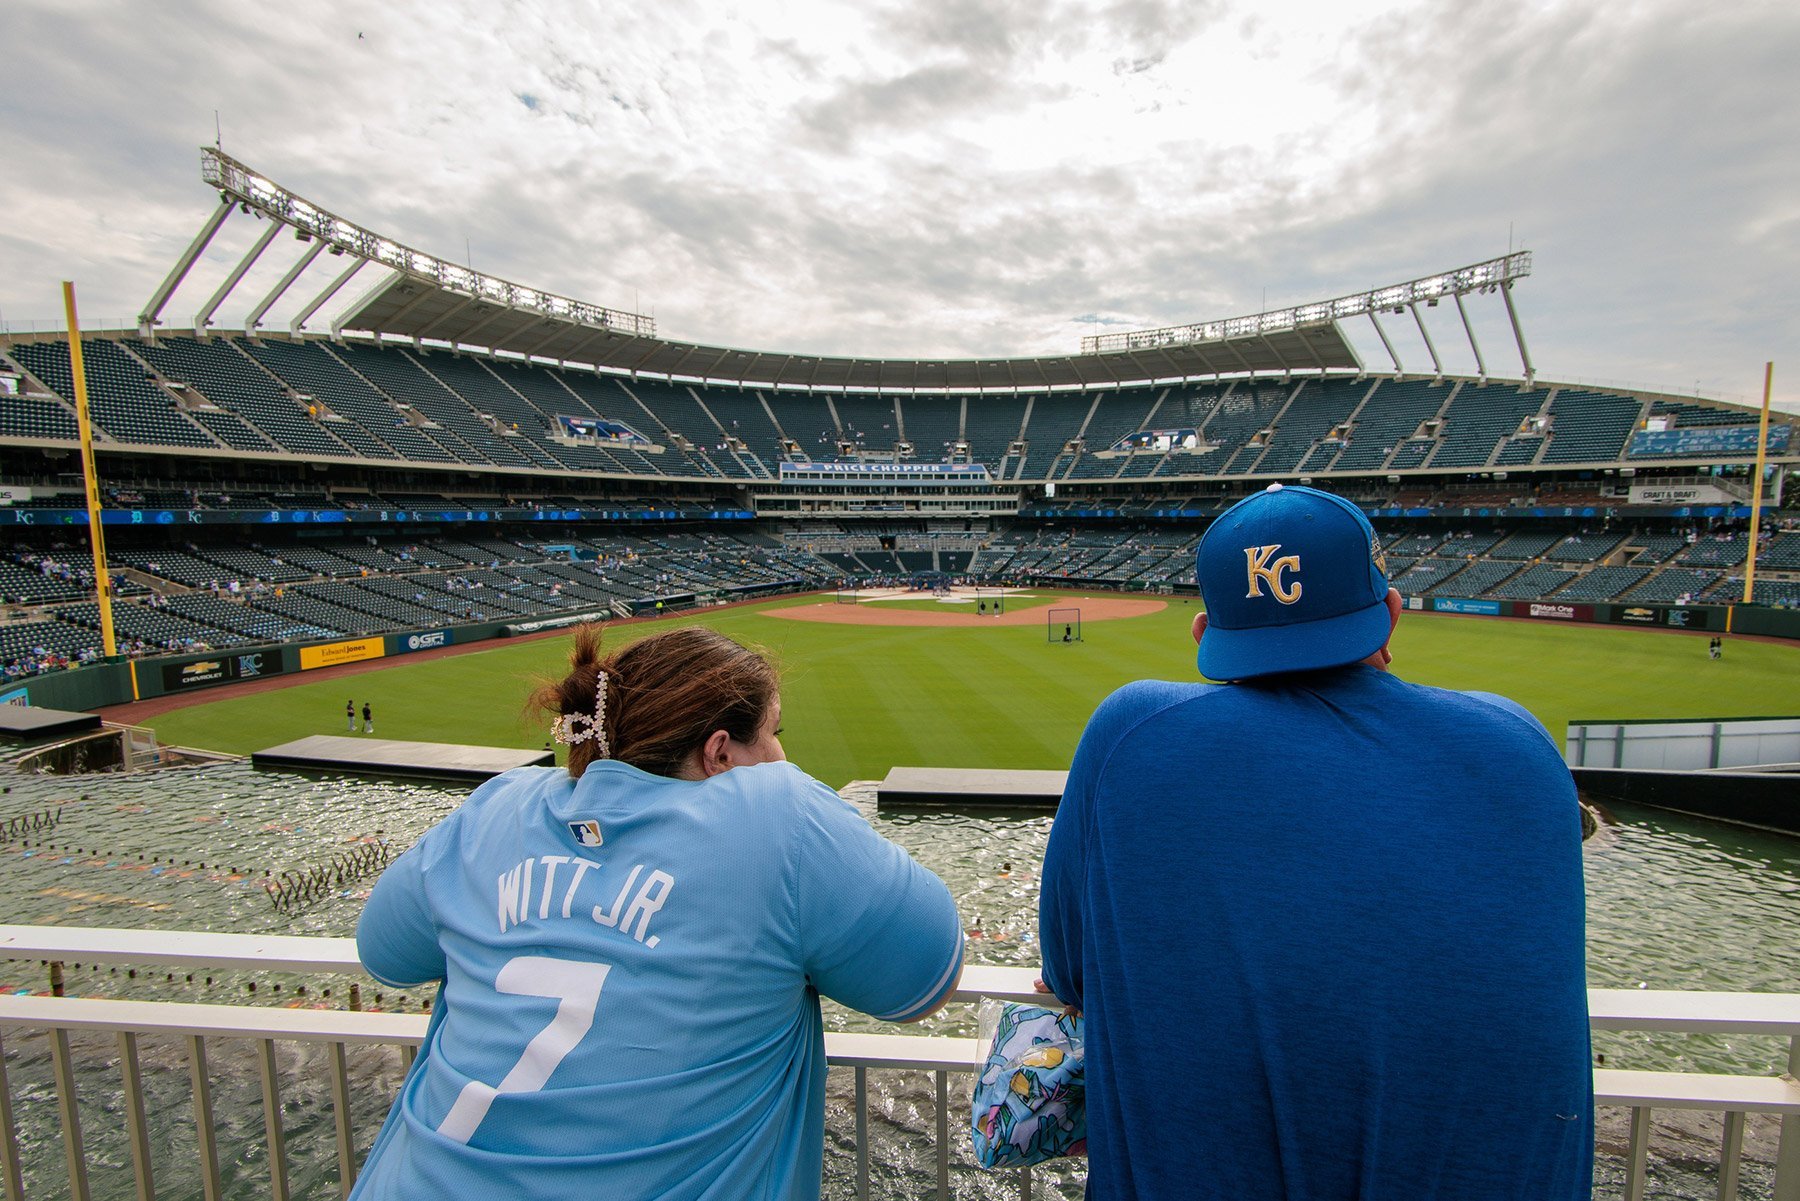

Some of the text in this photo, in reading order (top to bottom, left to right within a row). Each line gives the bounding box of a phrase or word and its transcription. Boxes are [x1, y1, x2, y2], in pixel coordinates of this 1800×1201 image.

[823, 464, 940, 472] PRICE CHOPPER
[1643, 491, 1665, 499] CRAFT
[1673, 491, 1697, 499] DRAFT
[15, 510, 34, 525] KC
[188, 511, 202, 523] KC
[1243, 544, 1303, 605] KC
[1437, 602, 1460, 611] UMKC
[1538, 604, 1574, 613] Mark One
[321, 644, 366, 656] Edward Jones
[182, 672, 223, 683] CHEVROLET
[498, 855, 675, 949] WITT JR.
[436, 956, 612, 1145] 7
